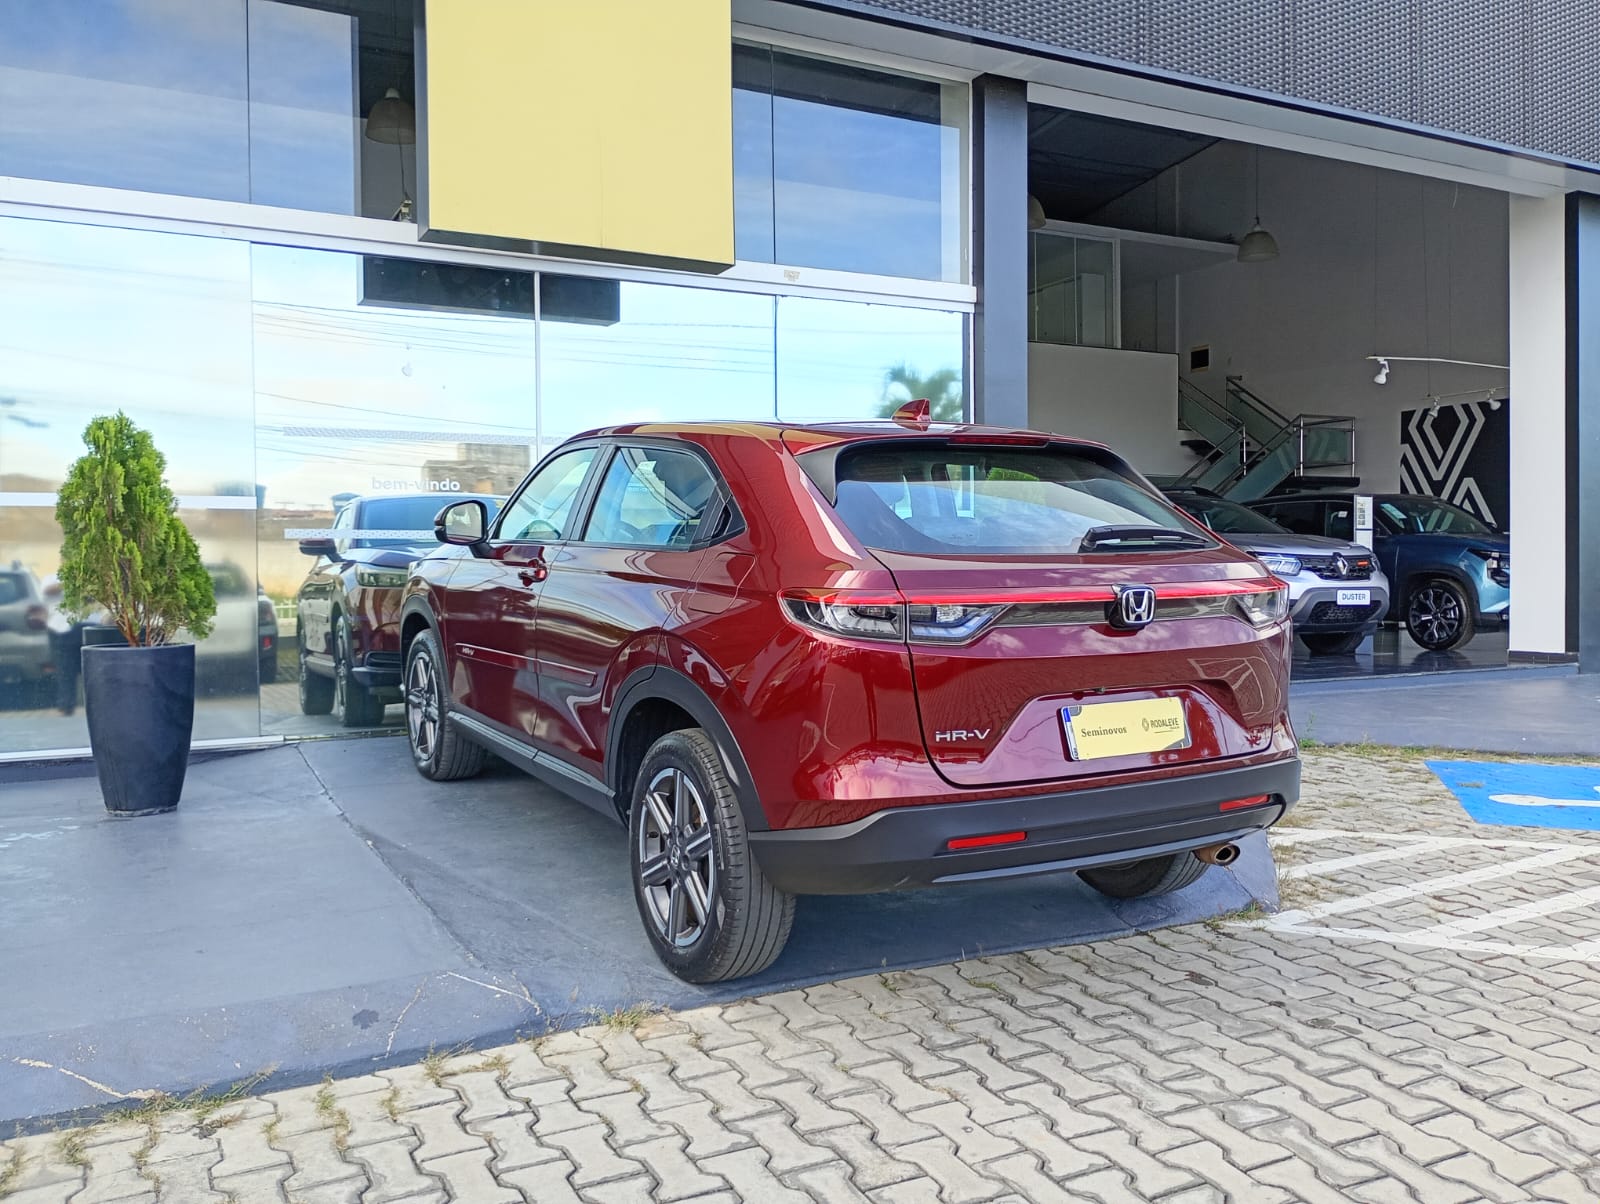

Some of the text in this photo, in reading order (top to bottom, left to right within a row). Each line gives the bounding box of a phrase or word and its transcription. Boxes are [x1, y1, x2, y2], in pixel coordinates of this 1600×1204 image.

[372, 477, 460, 491] bem-vindo
[1342, 593, 1366, 601] DUSTER
[1150, 717, 1180, 728] RODALEVE
[935, 728, 991, 742] HR-V
[1081, 726, 1127, 738] Seminovos
